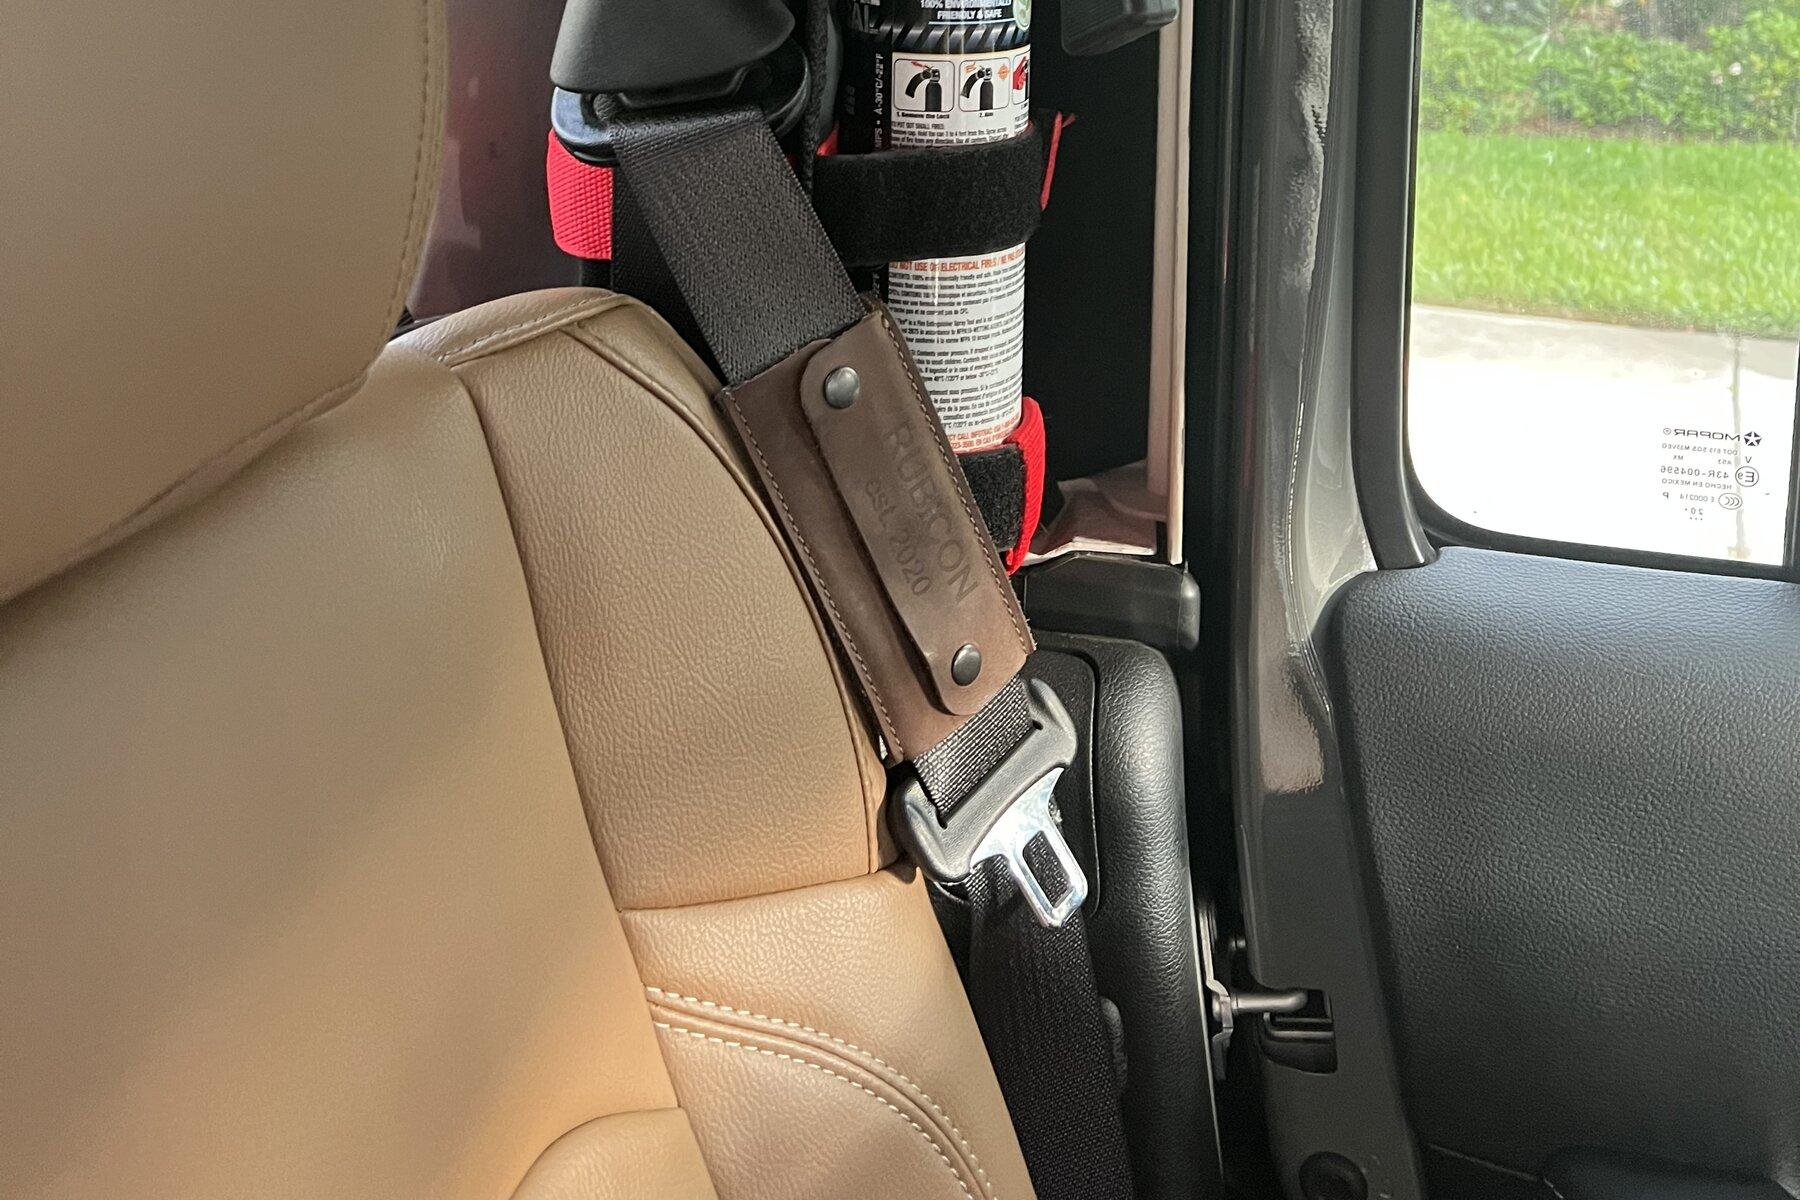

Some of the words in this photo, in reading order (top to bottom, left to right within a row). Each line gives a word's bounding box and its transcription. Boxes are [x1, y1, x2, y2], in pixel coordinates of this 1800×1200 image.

[920, 0, 944, 9] 100%
[937, 10, 976, 20] FRIENDLY
[984, 8, 1003, 19] SAFE
[915, 261, 928, 271] USE
[941, 260, 980, 272] ELECTRICAL
[889, 422, 980, 604] RUBICON
[888, 528, 932, 597] 2020
